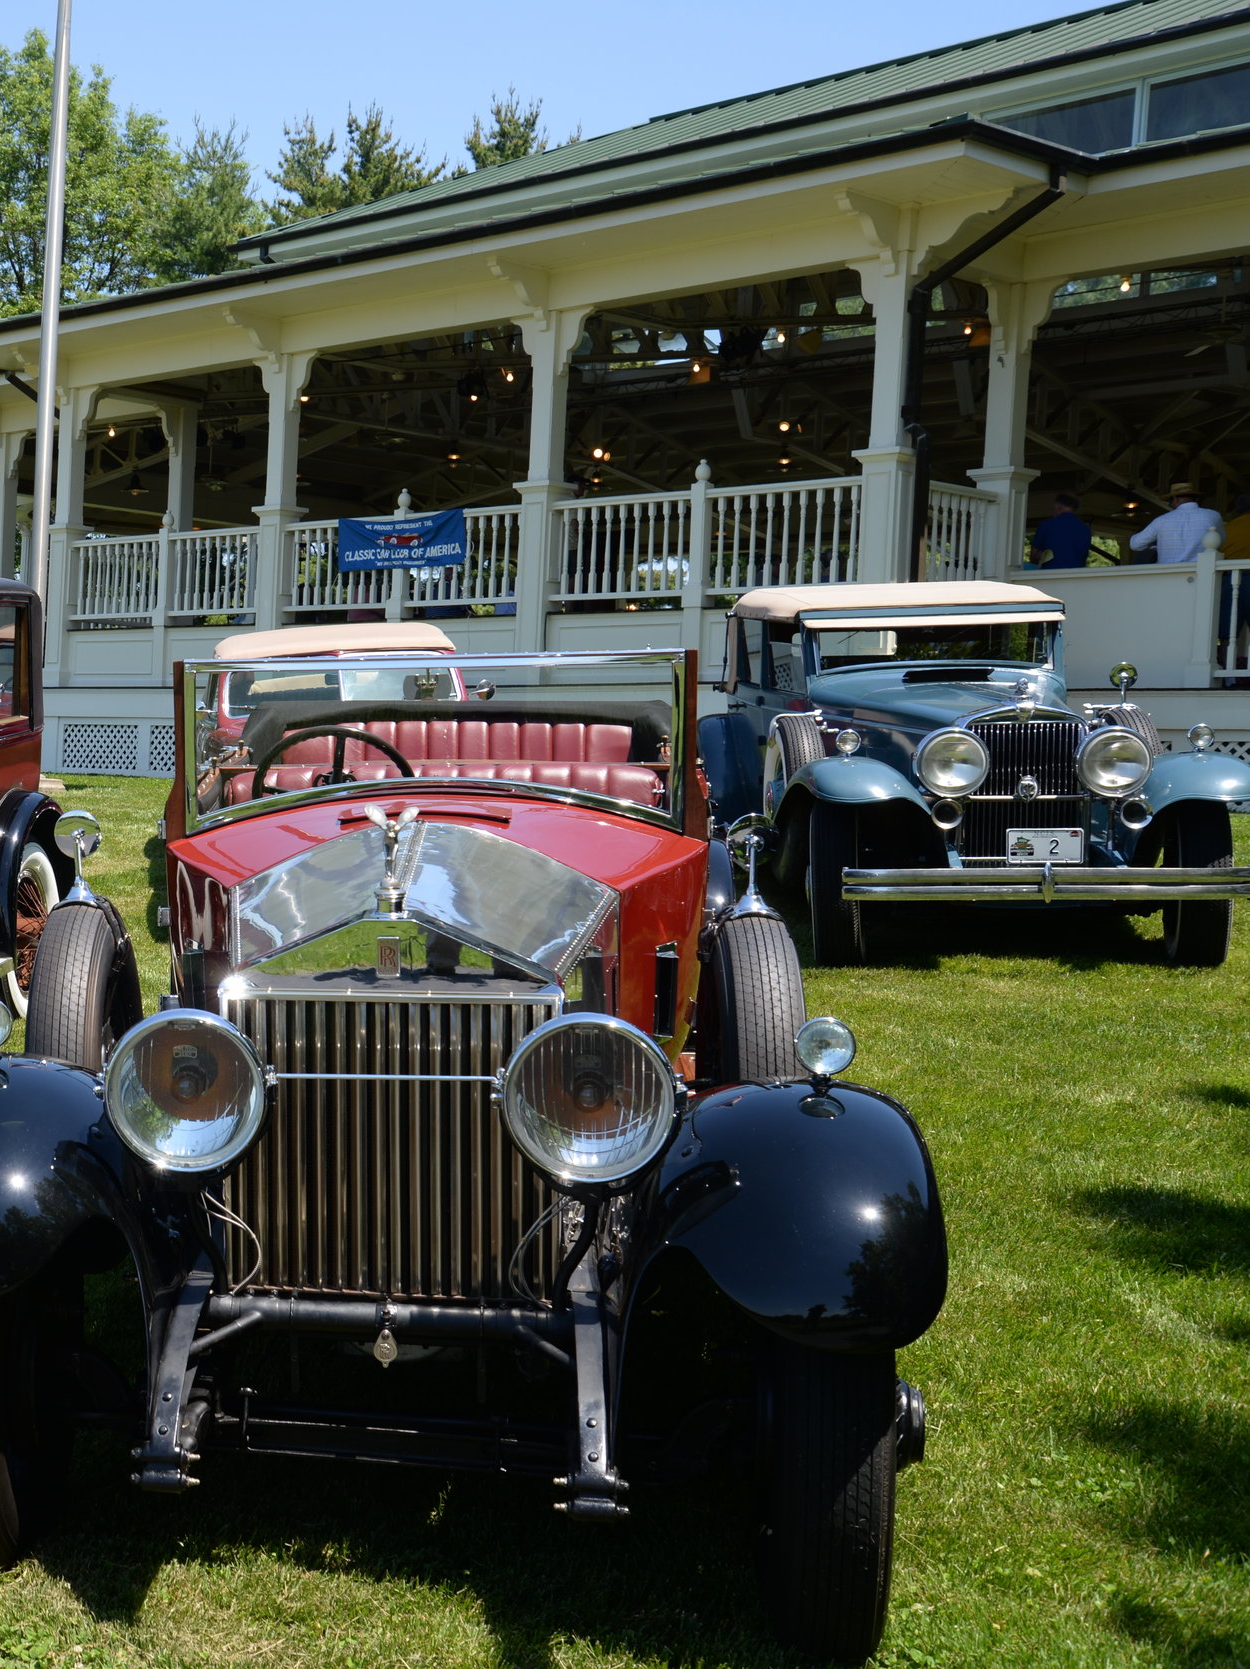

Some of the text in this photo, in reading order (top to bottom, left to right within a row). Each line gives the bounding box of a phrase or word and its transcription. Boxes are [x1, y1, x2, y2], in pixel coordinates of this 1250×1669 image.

[395, 521, 422, 530] REPRESENT
[344, 549, 375, 562] CLASSIC
[376, 548, 389, 560] CAR
[411, 548, 424, 559] OF
[425, 542, 462, 558] AMERICA
[1049, 839, 1059, 855] 2
